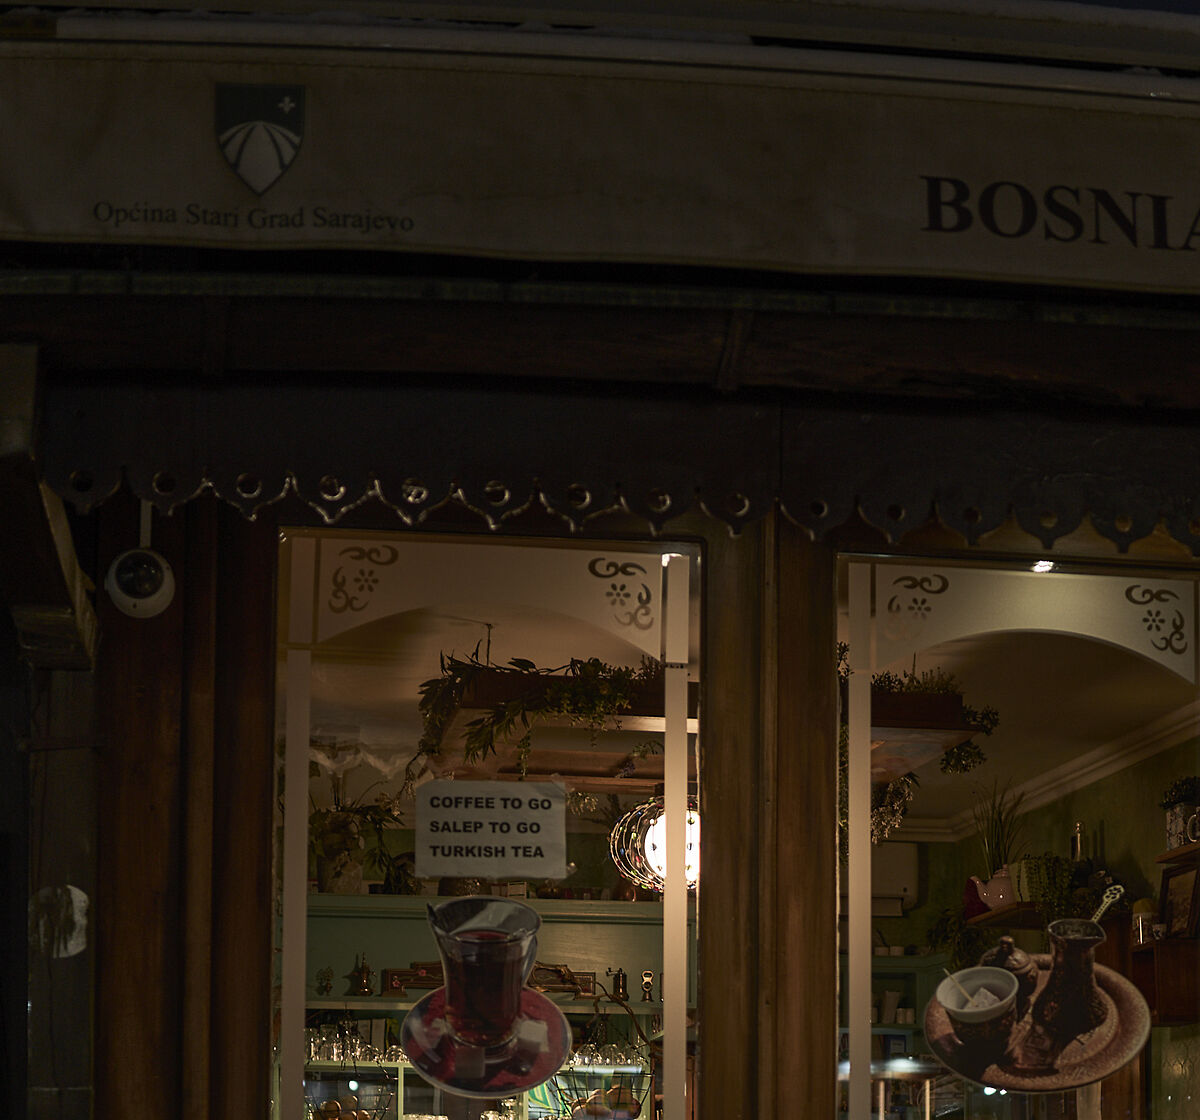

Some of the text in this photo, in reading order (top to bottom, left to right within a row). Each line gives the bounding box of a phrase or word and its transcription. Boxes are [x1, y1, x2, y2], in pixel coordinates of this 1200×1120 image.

[93, 201, 415, 234] Općina Stari Grad Sarajevo
[430, 796, 552, 810] COFFEE TO GO
[430, 821, 540, 833] SALEP TO GO
[430, 845, 544, 858] TURKISH TEA
